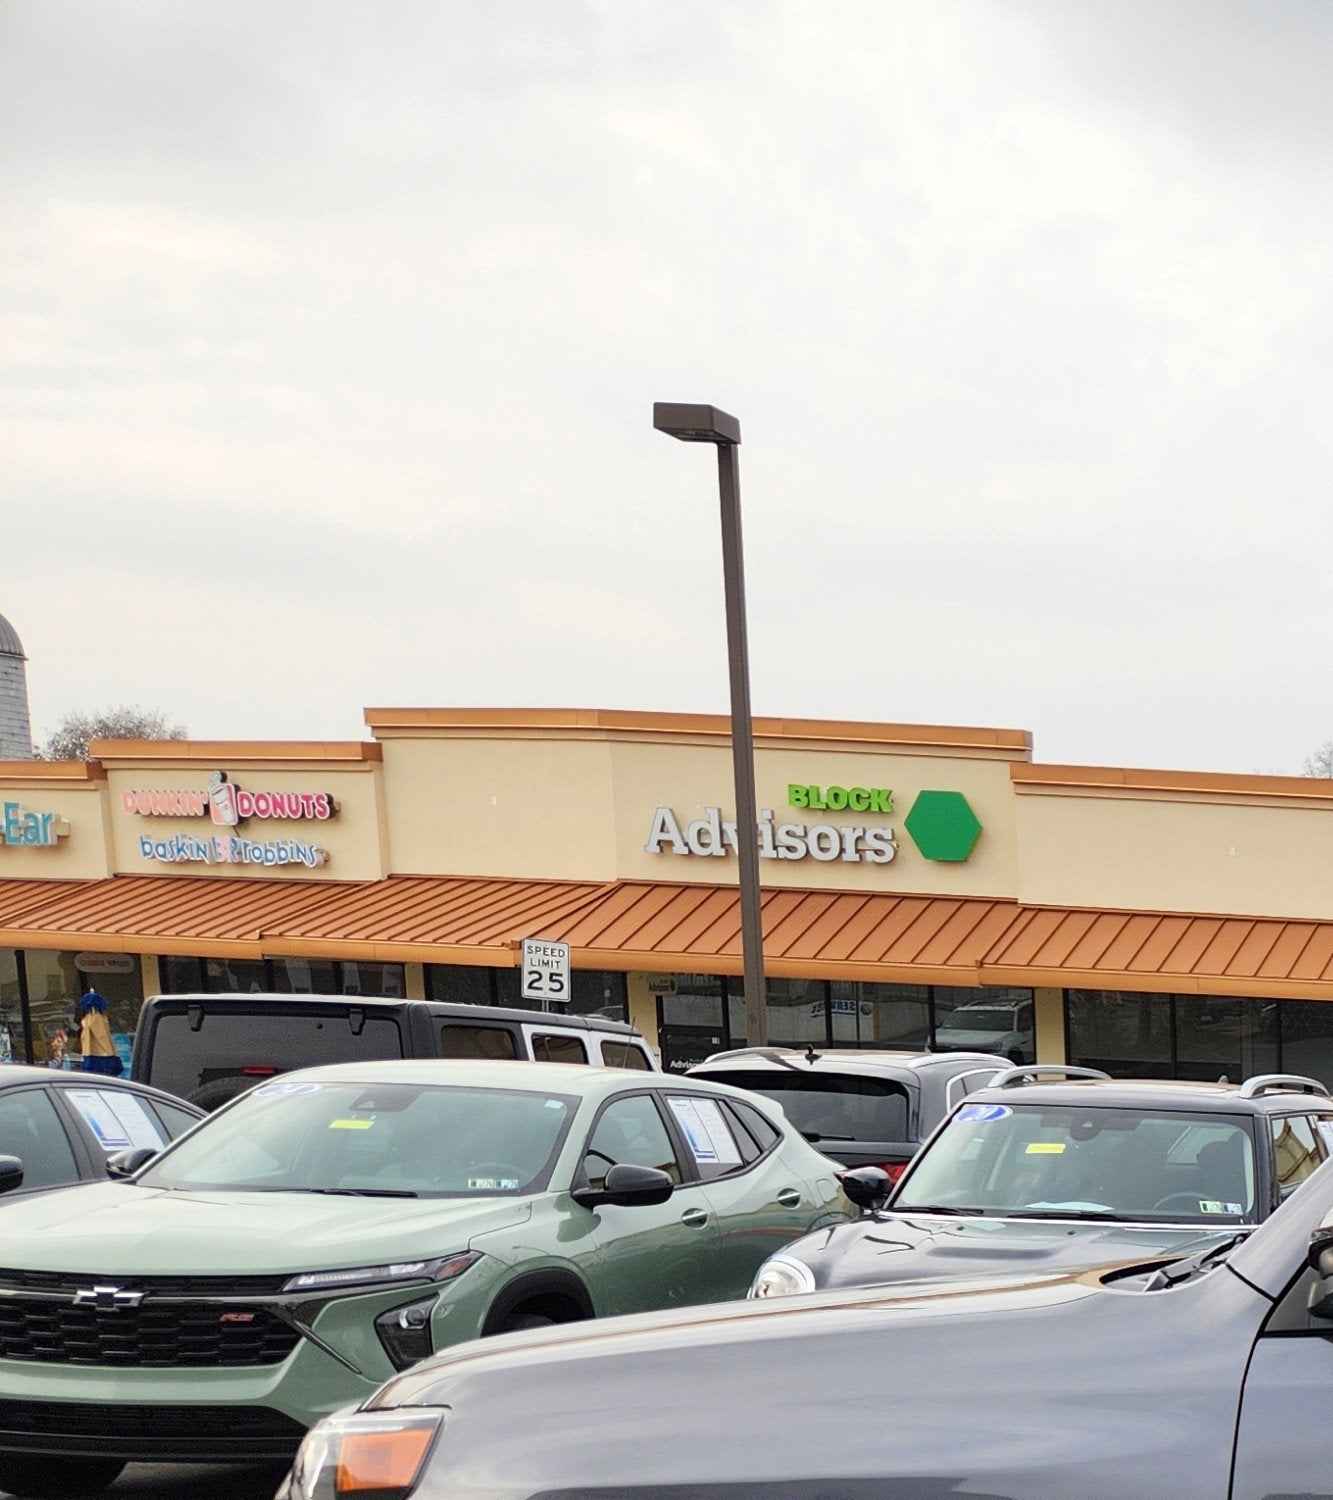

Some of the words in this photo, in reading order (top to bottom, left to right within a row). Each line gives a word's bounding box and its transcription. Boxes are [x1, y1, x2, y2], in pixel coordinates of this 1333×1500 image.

[120, 789, 209, 817] DUNKIN'
[237, 790, 331, 820] DONUTS
[787, 783, 894, 813] BLOCK
[139, 834, 209, 863] baskin
[241, 839, 316, 868] robbins
[527, 945, 565, 958] SPEED
[530, 958, 561, 969] LIMIT
[527, 970, 565, 993] 25
